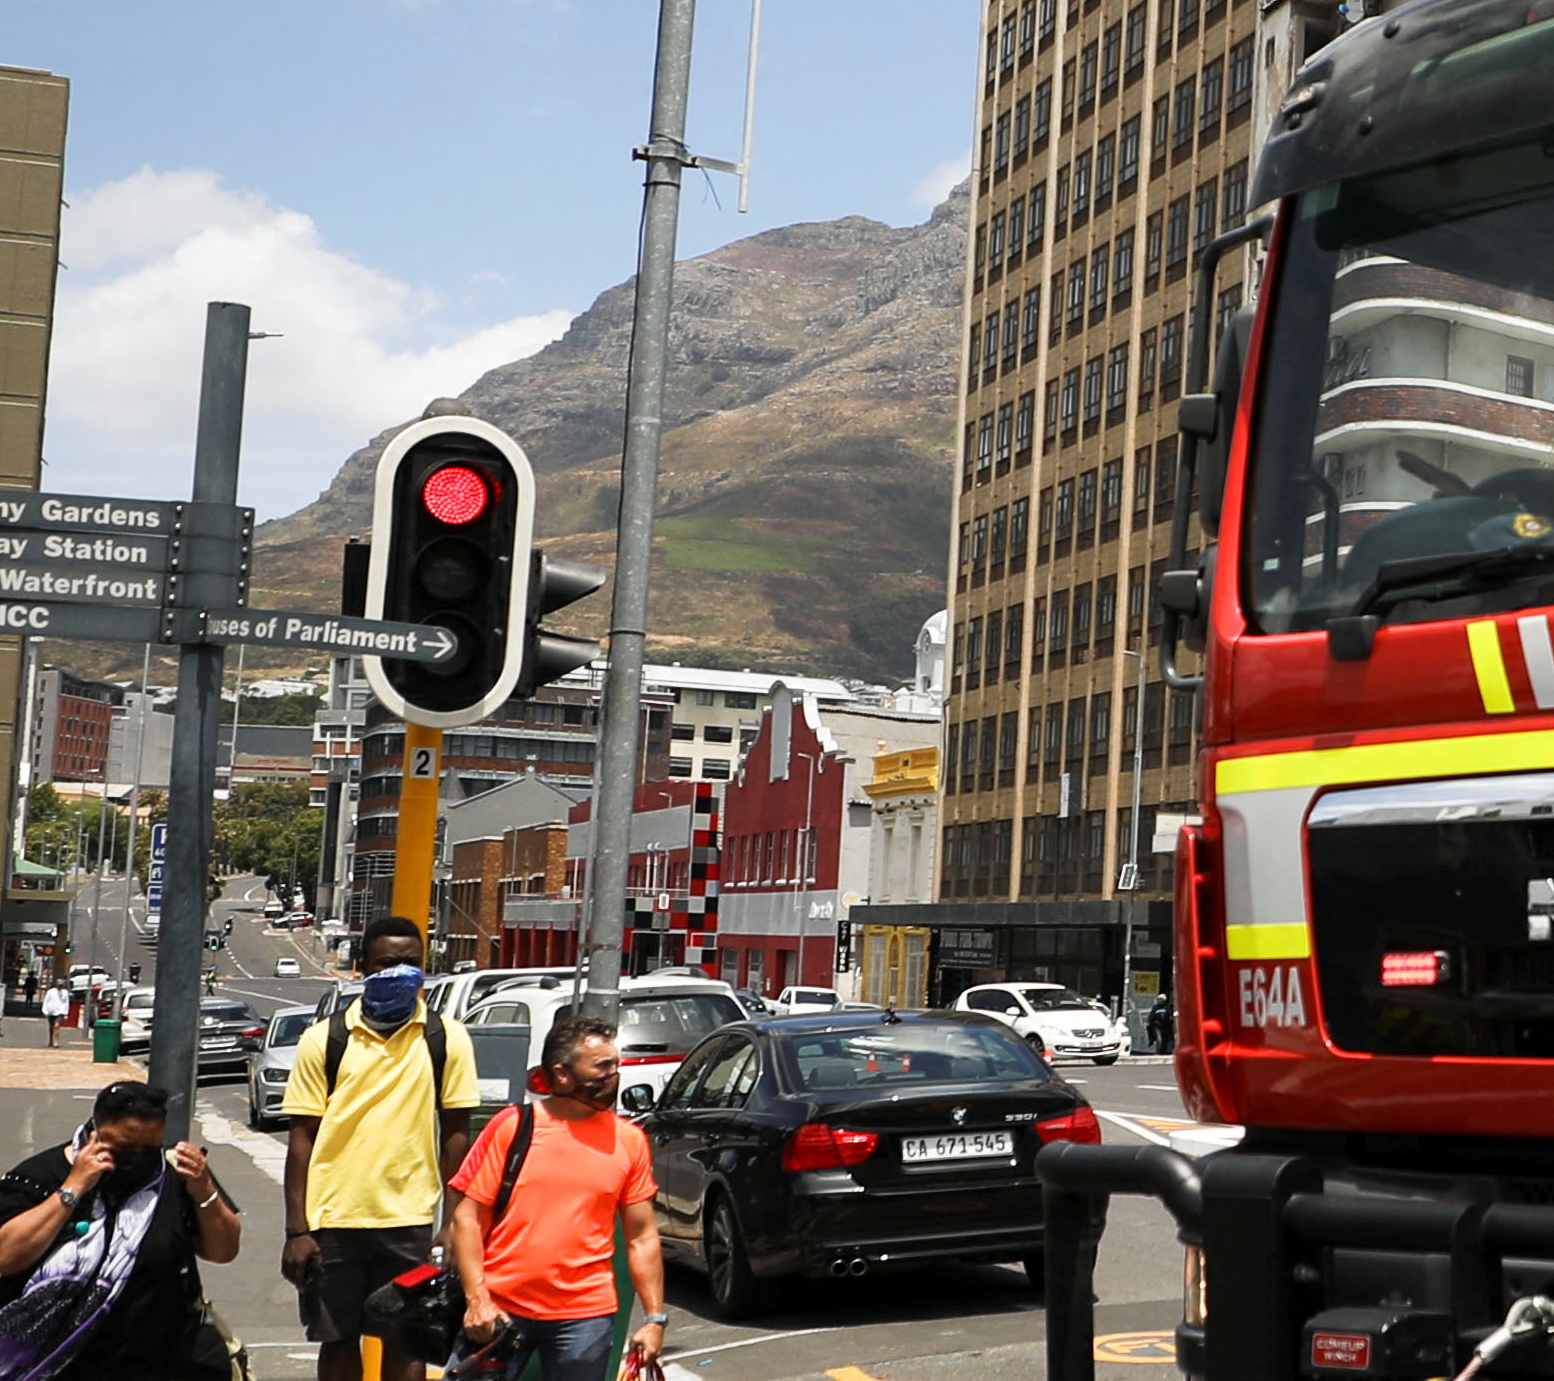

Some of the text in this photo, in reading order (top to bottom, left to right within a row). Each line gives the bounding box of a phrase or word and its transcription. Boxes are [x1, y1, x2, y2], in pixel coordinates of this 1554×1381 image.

[42, 499, 161, 529] Gardens
[43, 535, 148, 564] Station
[254, 617, 278, 638] of
[285, 619, 417, 653] Parliament
[415, 750, 429, 775] 2
[1241, 967, 1305, 1027] E64A
[906, 1134, 1005, 1157] CA 671-545
